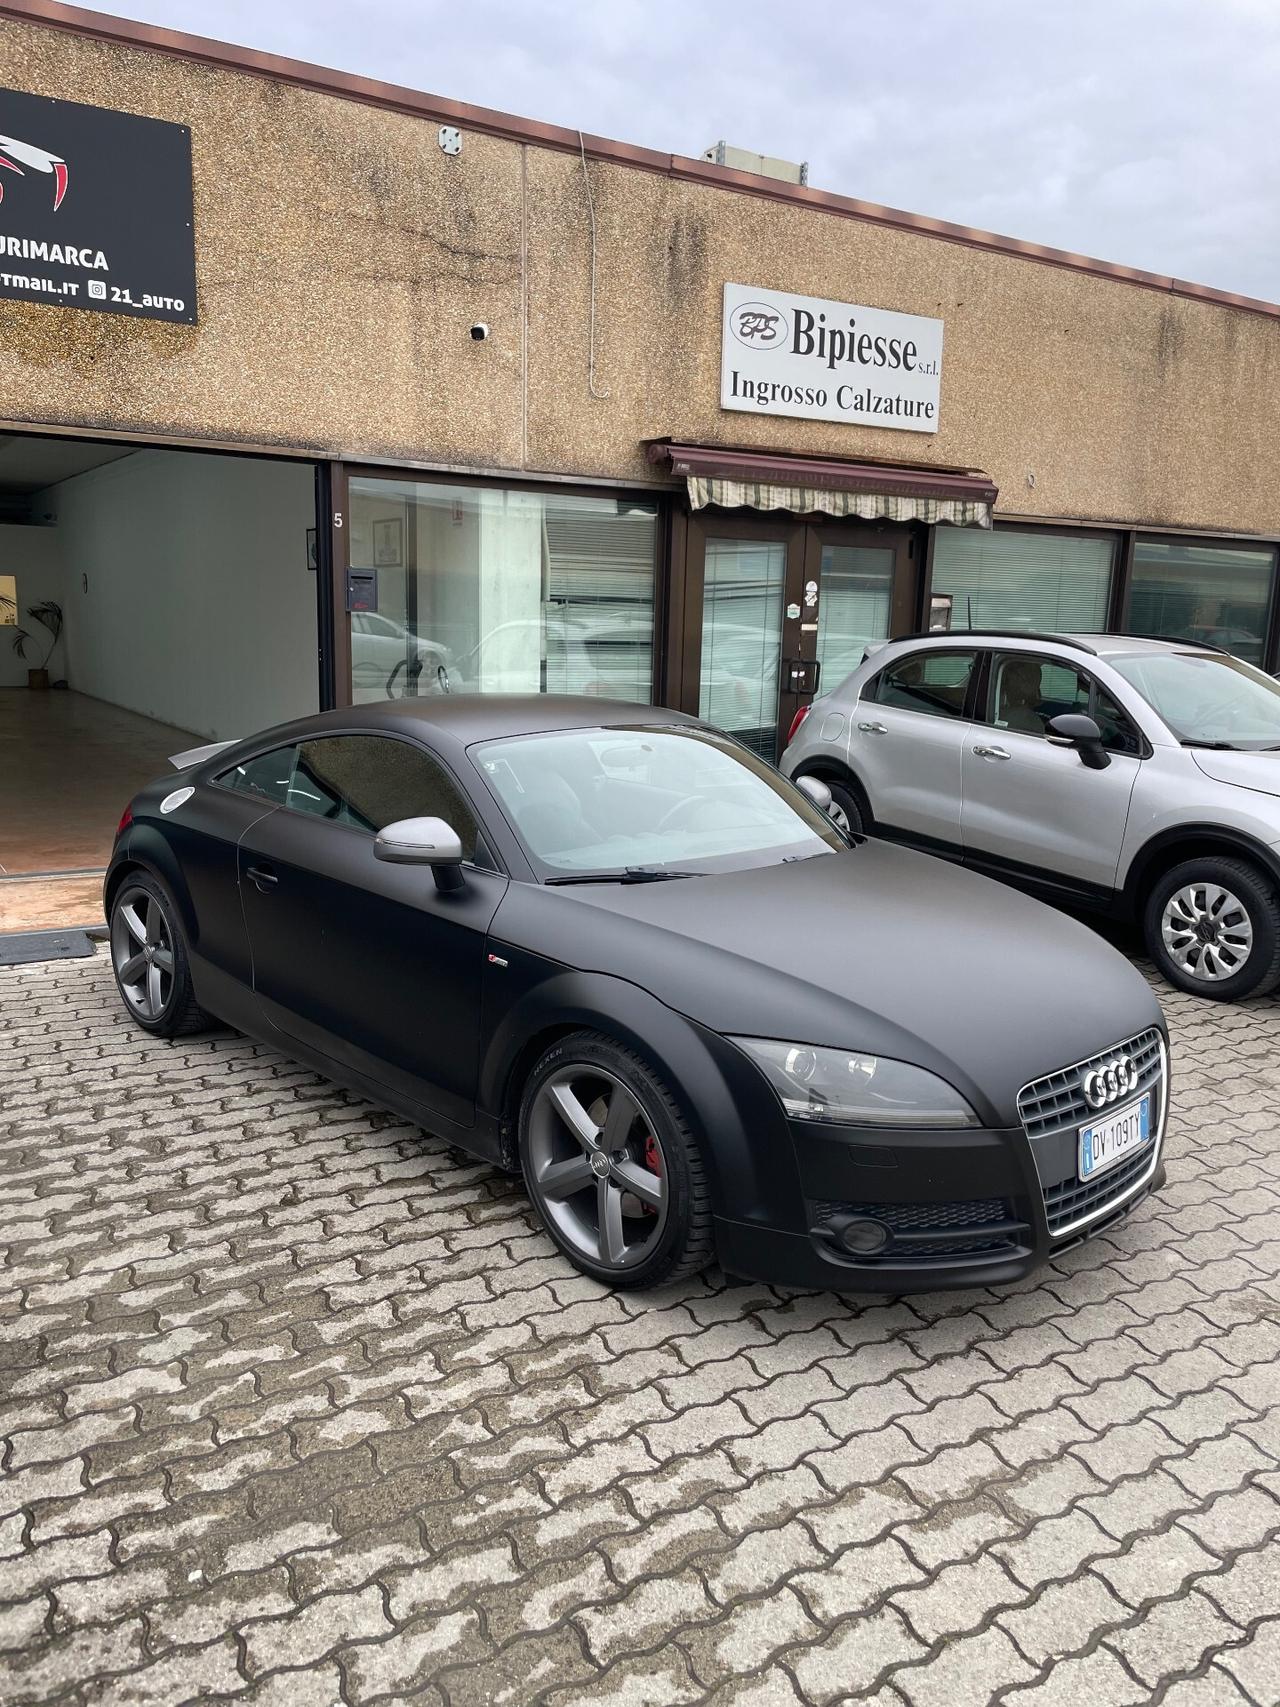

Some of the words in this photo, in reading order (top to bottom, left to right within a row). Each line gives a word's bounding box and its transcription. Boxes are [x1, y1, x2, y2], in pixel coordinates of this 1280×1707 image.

[790, 307, 917, 371] Bipiesse
[918, 360, 939, 376] s.r.l.
[730, 370, 828, 406] Ingrosso
[836, 385, 935, 418] Calzature
[334, 512, 343, 528] 5
[1111, 1111, 1140, 1151] 109TY
